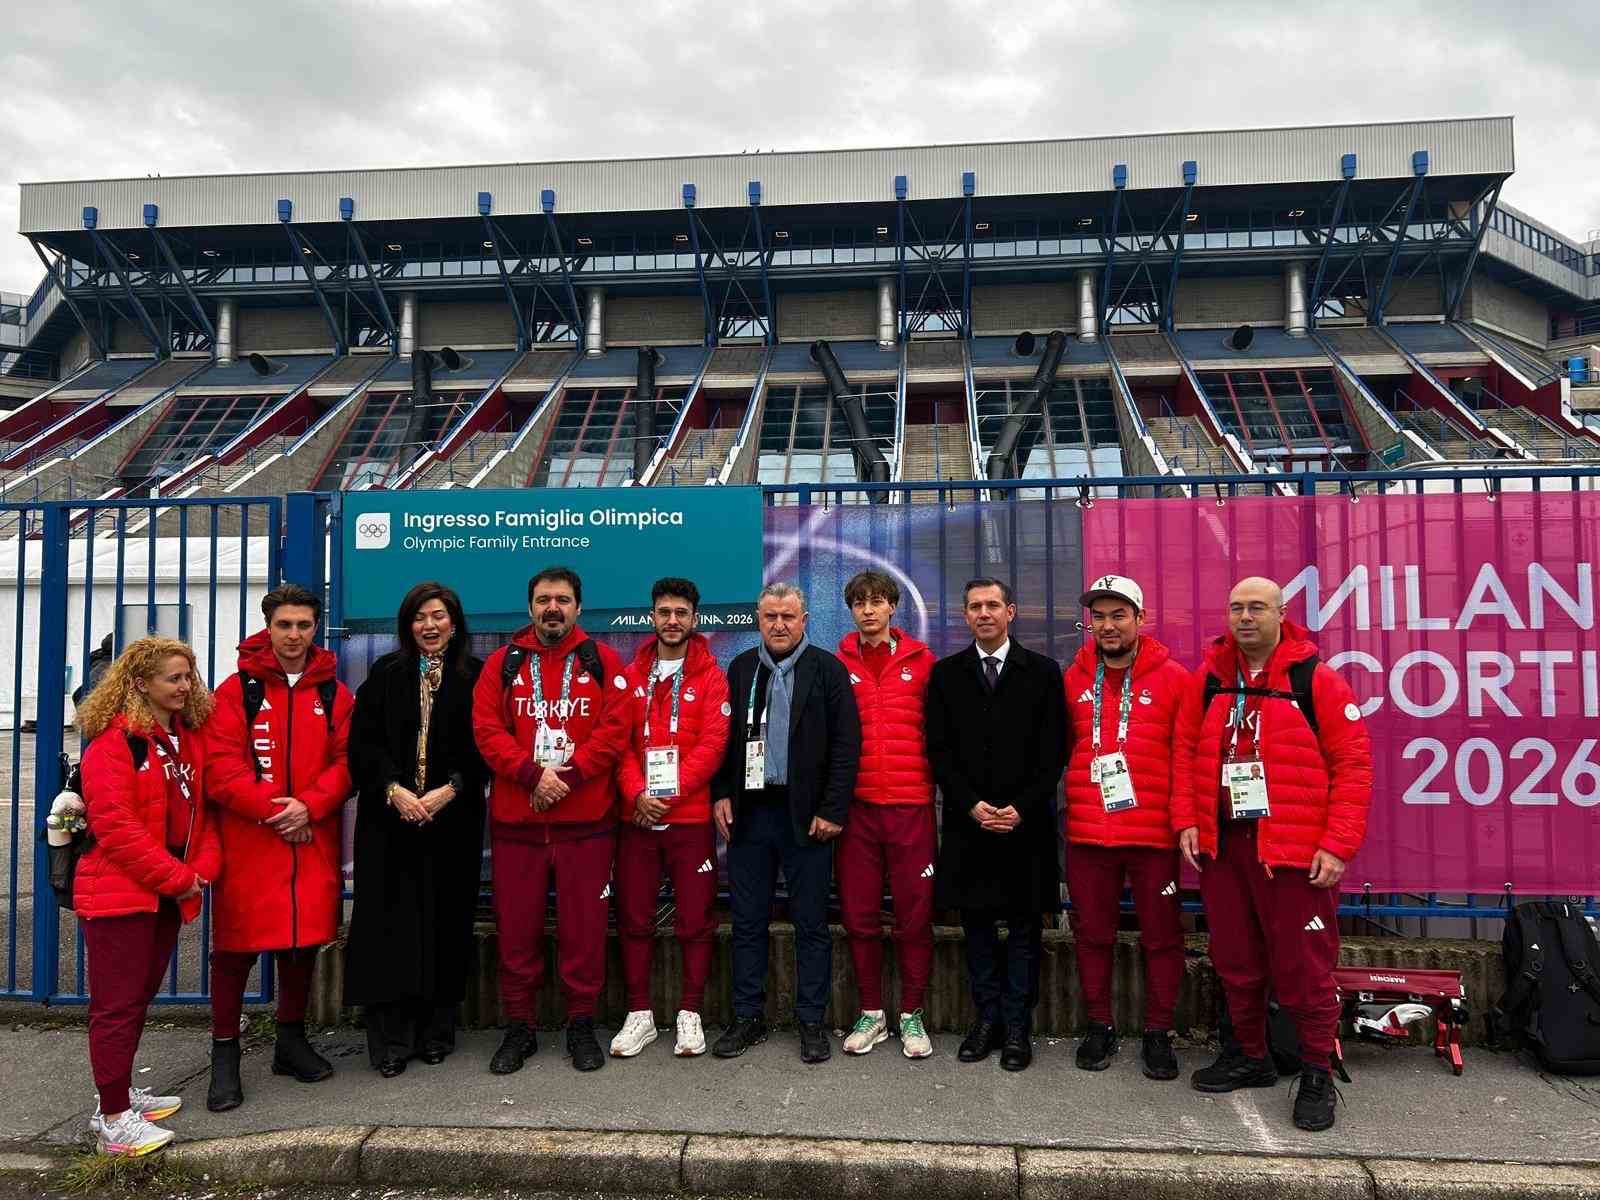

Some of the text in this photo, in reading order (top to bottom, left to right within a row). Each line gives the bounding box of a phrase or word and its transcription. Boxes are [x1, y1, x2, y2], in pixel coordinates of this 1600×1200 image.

[404, 508, 683, 533] Ingresso Famiglia Olimpica
[403, 535, 590, 553] Olympic Family Entrance
[1281, 562, 1593, 632] MILAN
[726, 614, 753, 625] 2026
[515, 697, 591, 718] TÜRKYE
[1402, 737, 1600, 807] 2026
